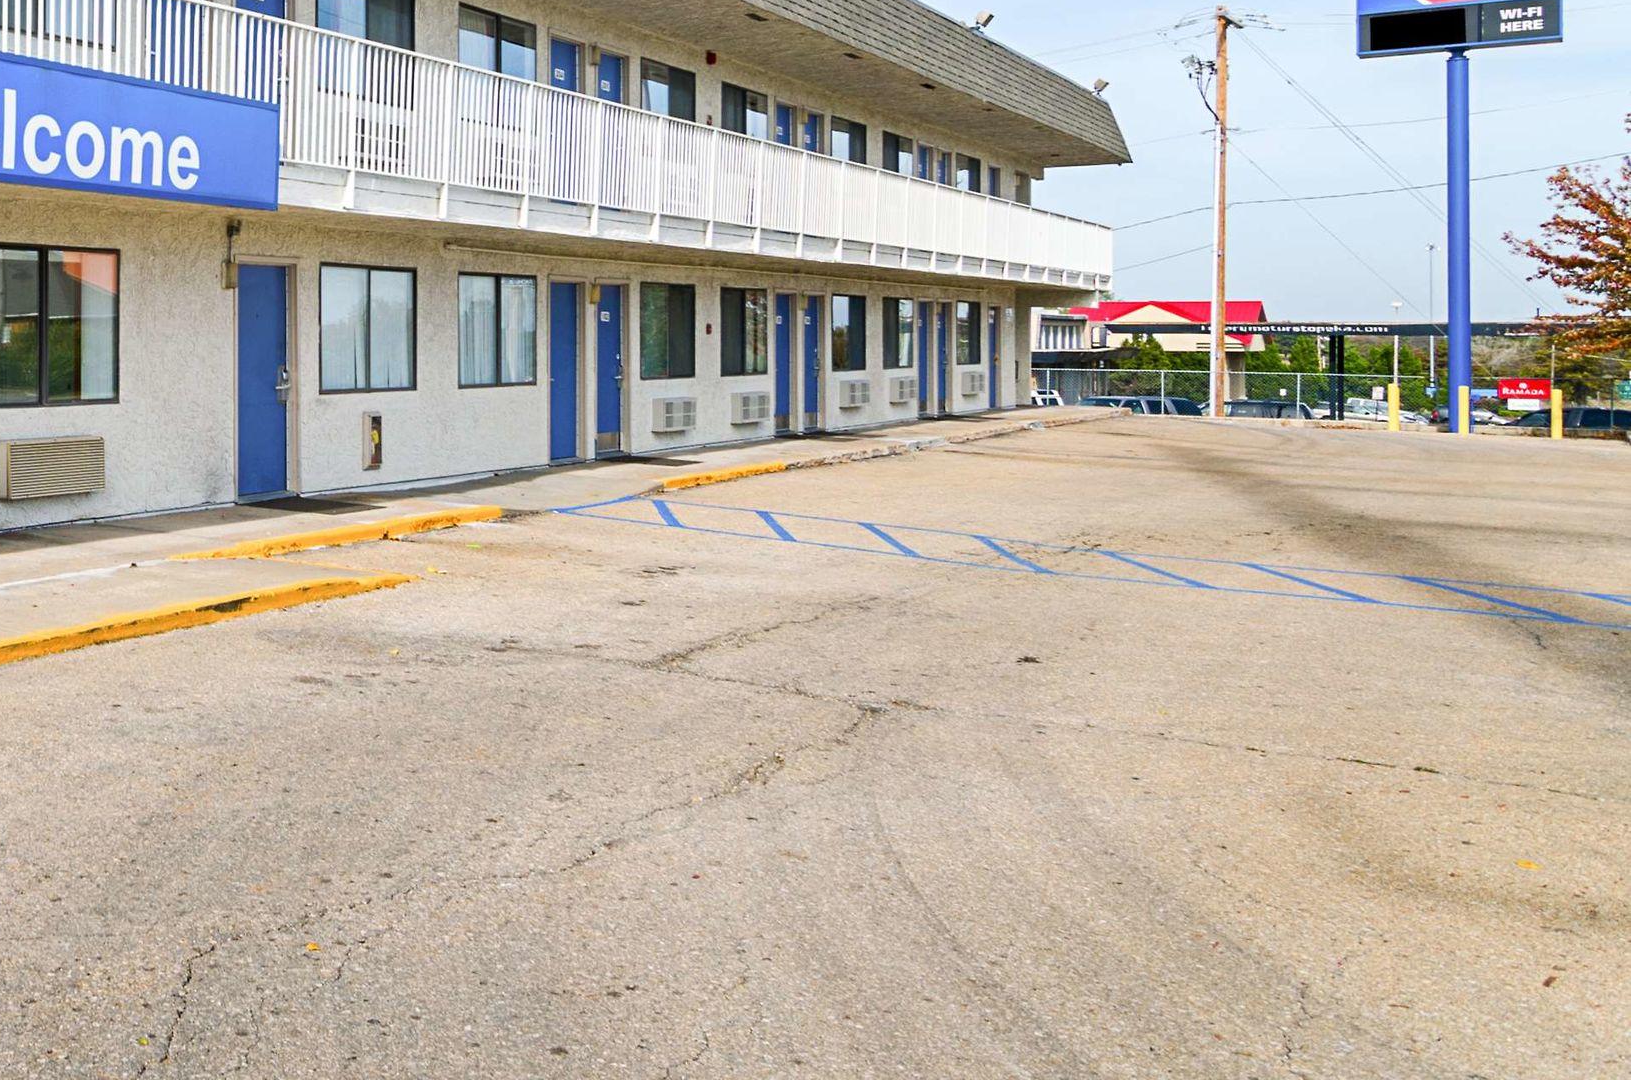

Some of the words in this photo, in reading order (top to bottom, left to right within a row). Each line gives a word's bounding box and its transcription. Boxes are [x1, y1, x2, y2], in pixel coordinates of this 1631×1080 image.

[1499, 6, 1543, 20] WI-FI
[1500, 19, 1544, 33] HERE
[1502, 387, 1544, 396] RAMADA
